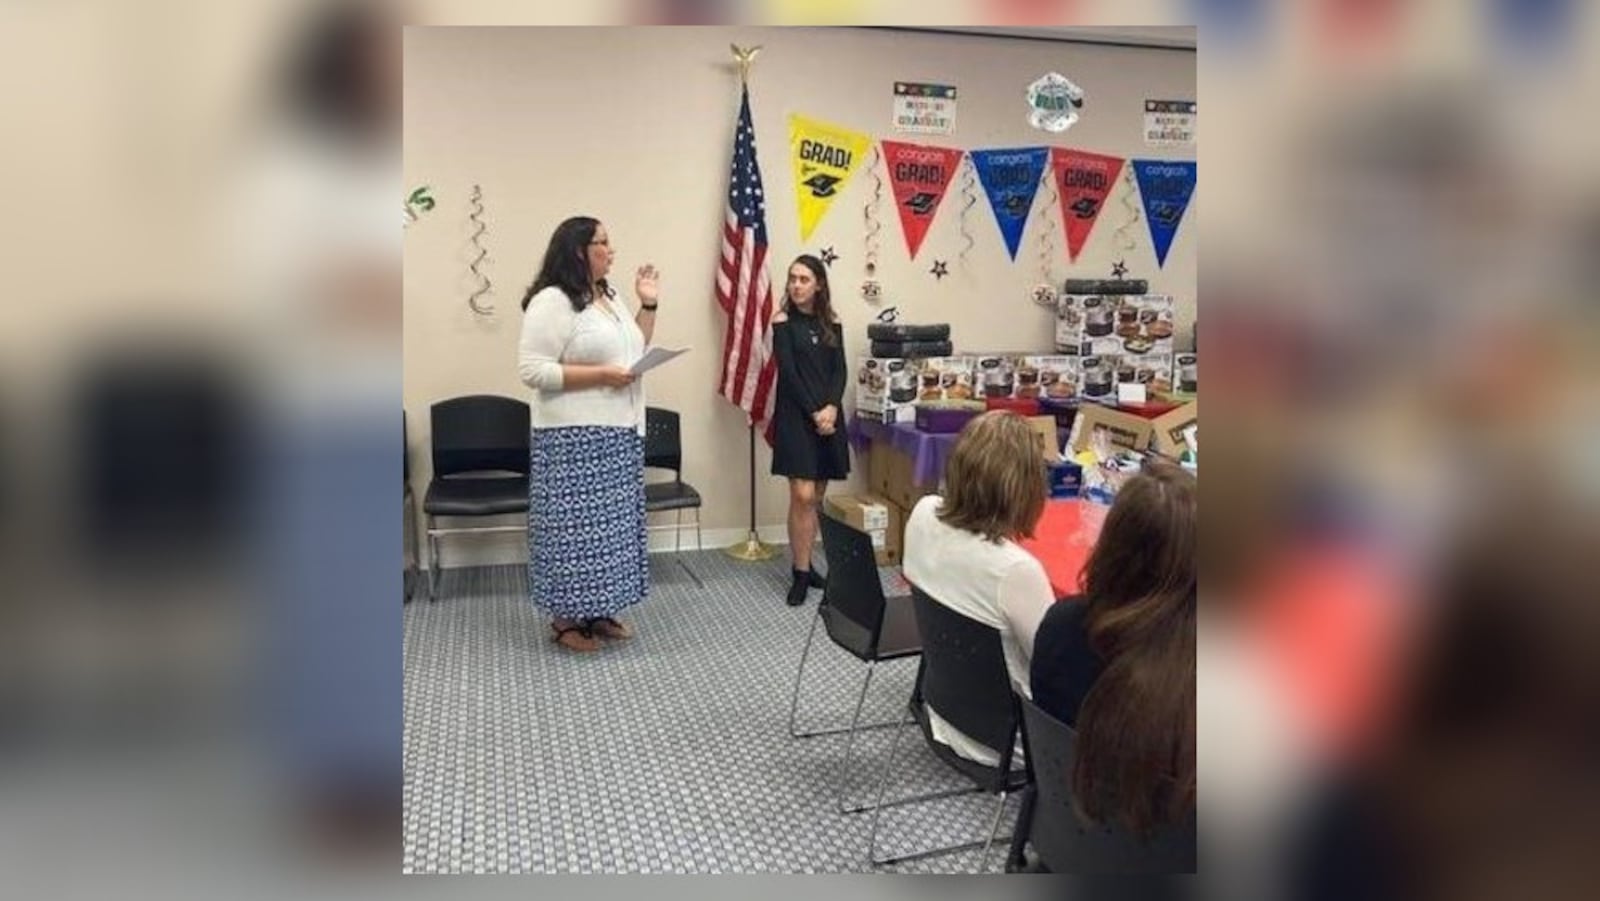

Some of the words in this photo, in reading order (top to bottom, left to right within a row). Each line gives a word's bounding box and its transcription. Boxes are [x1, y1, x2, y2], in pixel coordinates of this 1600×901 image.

[799, 138, 852, 171] GRAD!
[896, 162, 946, 185] GRAD!
[1064, 168, 1108, 191] GRAD!
